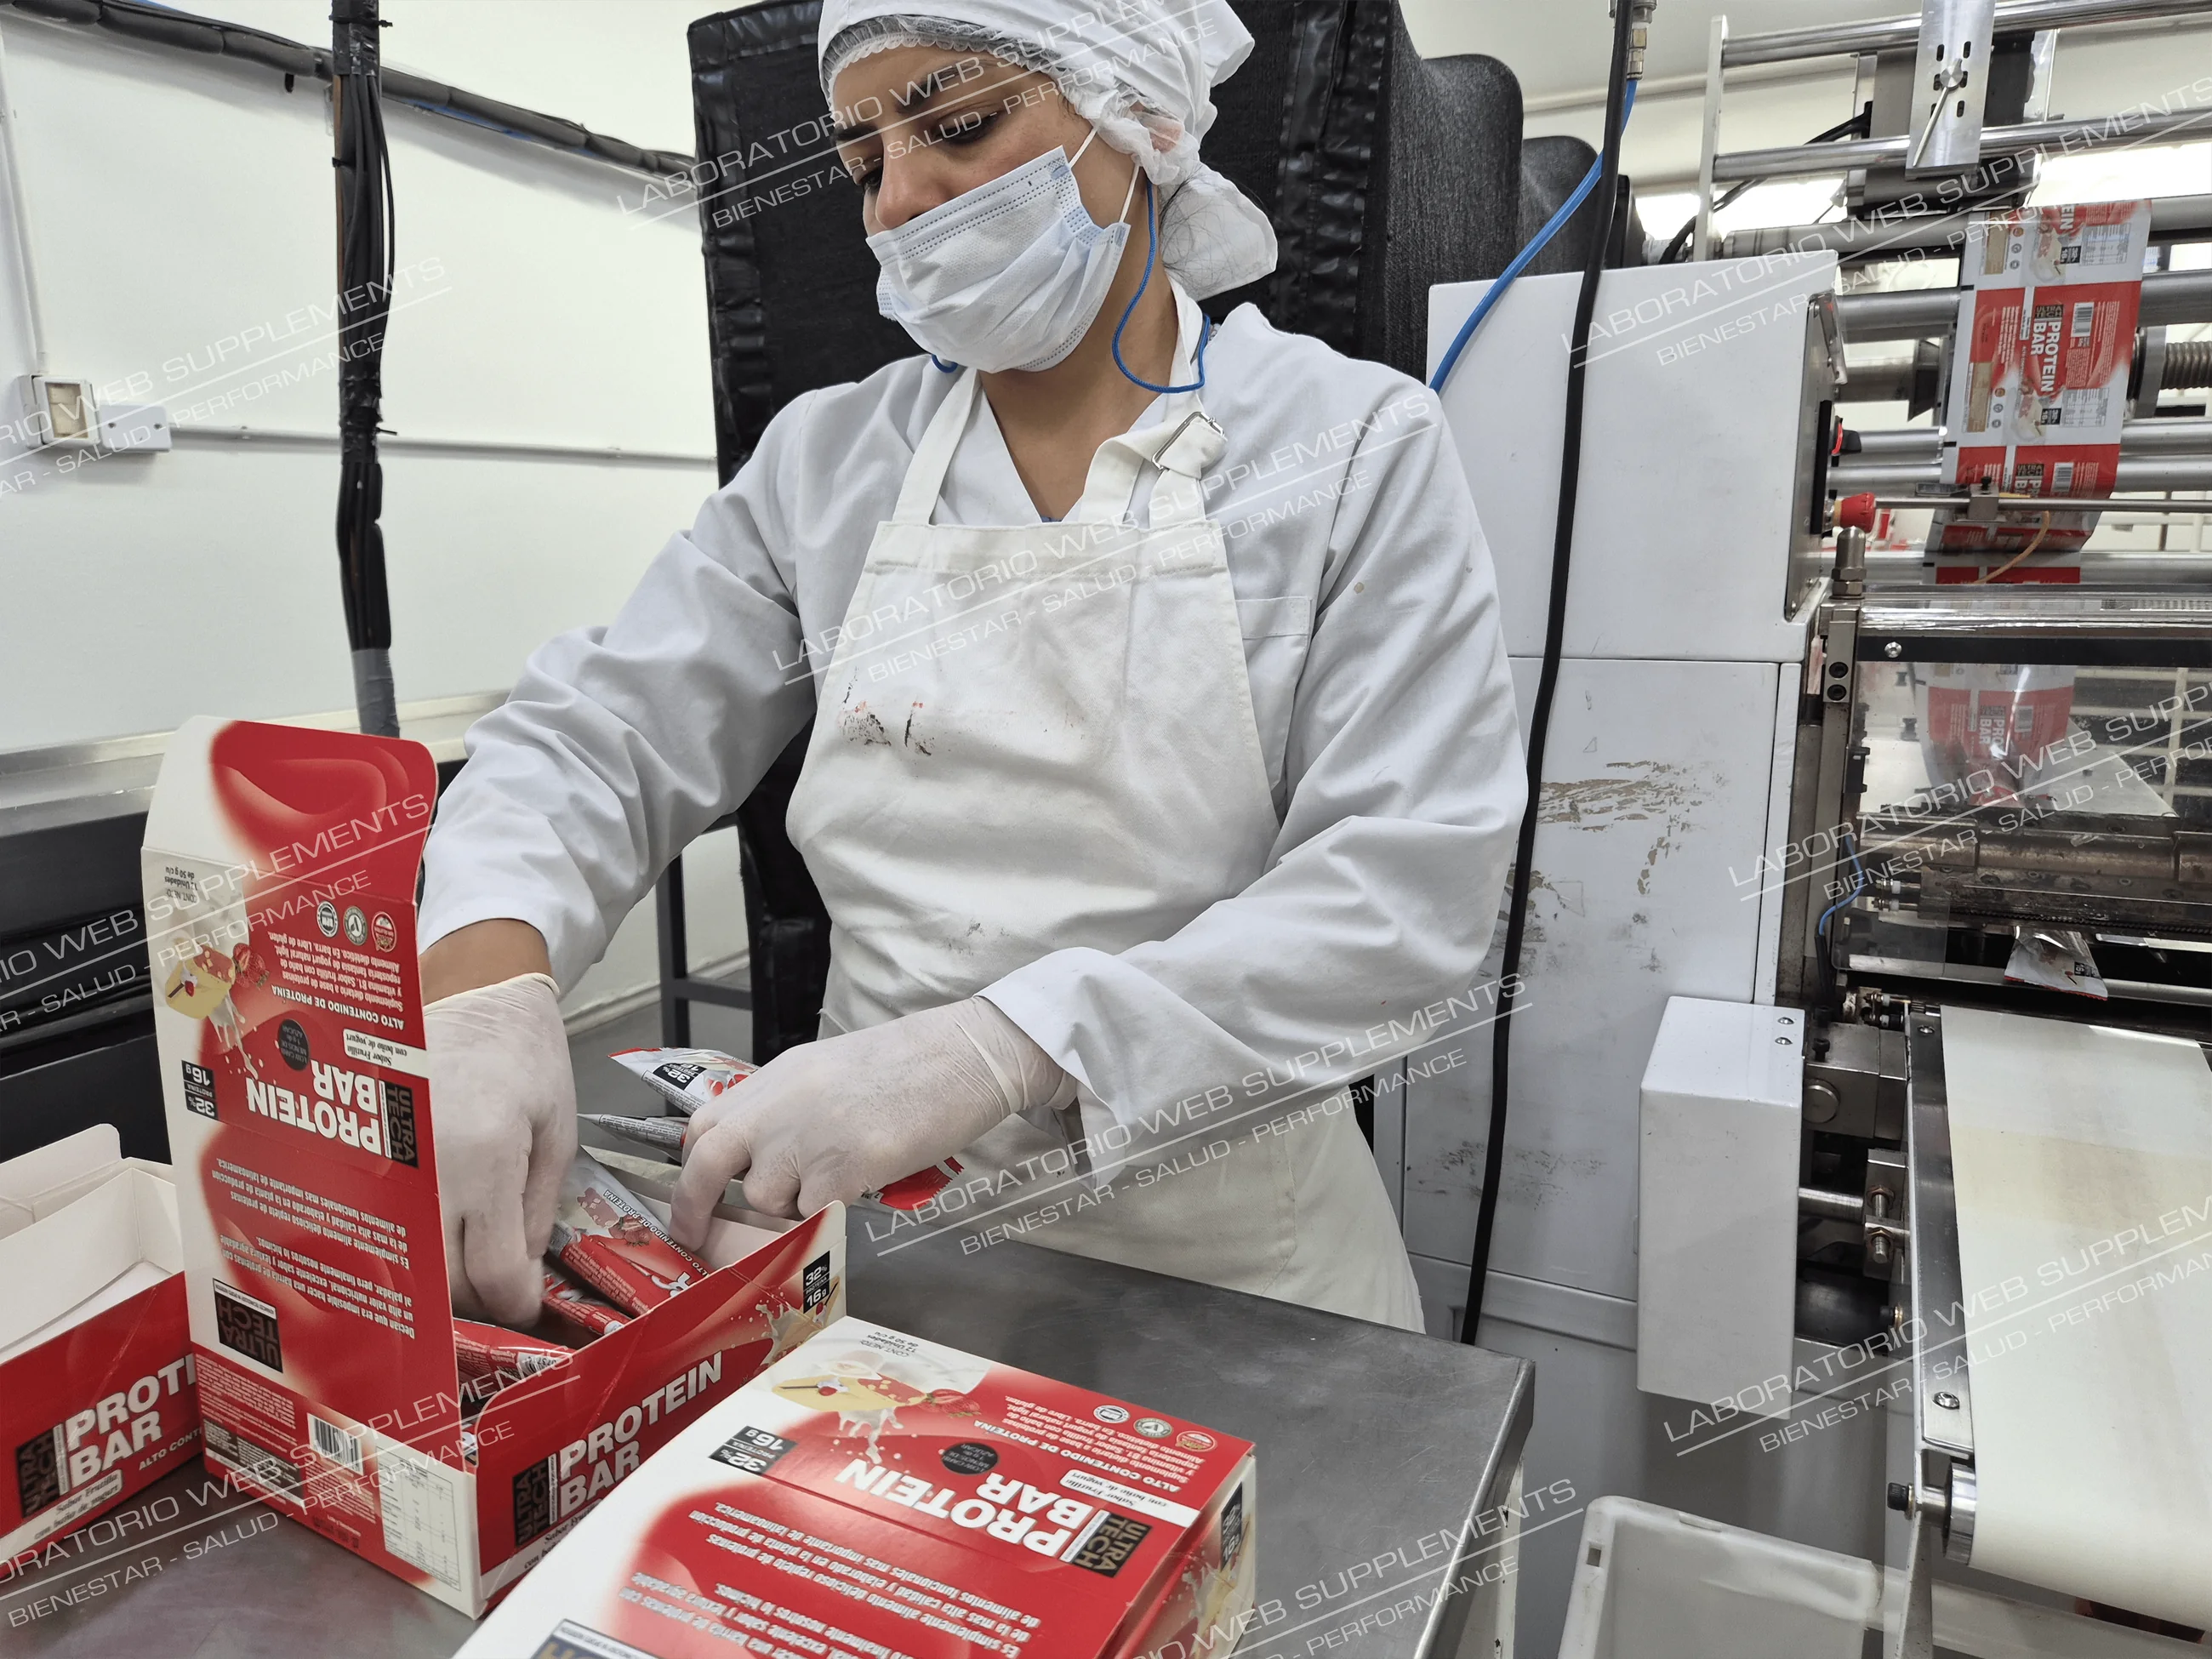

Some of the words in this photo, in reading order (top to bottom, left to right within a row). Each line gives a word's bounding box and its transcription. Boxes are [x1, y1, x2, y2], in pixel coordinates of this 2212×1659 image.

[2031, 322, 2047, 356] BAR
[2041, 322, 2062, 391] PROTEIN
[1980, 719, 1992, 744] BAR
[163, 875, 190, 890] Unidades
[178, 869, 186, 879] 50
[314, 995, 326, 1009] DE
[327, 999, 379, 1024] CONTENIDO
[379, 1013, 404, 1030] ALTO
[345, 1030, 368, 1046] yogurt
[368, 1039, 375, 1050] de
[376, 1040, 393, 1055] baño
[346, 1044, 371, 1060] Frutilla
[372, 1052, 391, 1066] Sabor
[394, 1046, 407, 1057] con
[185, 1063, 211, 1086] 16g
[310, 1058, 378, 1115] BAR
[188, 1096, 215, 1117] 32%
[244, 1075, 382, 1155] PROTEIN
[385, 1082, 403, 1161] TECH
[398, 1086, 416, 1166] ULTRA
[603, 1189, 640, 1220] PROTEINA
[649, 1225, 693, 1263] CONTENIDO
[692, 1261, 711, 1279] LTO
[805, 1265, 828, 1286] 32%
[807, 1288, 827, 1307] 16g
[216, 1295, 278, 1344] TECH
[219, 1319, 280, 1368] ULTRA
[560, 1348, 722, 1484] PROTEIN
[68, 1405, 162, 1491] BAR
[738, 1427, 790, 1452] 16g
[1038, 1440, 1061, 1453] DE
[138, 1446, 167, 1471] ALTO
[713, 1445, 769, 1474] 32%
[1058, 1447, 1143, 1481] CONTENIDO
[560, 1434, 640, 1519] BAR
[1140, 1474, 1181, 1494] ALTO
[532, 1462, 548, 1532] TECH
[832, 1454, 1073, 1561] PROTEIN
[971, 1470, 1094, 1531] BAR
[744, 1531, 767, 1545] de
[760, 1535, 803, 1559] planta
[1073, 1513, 1129, 1570] TECH
[1092, 1519, 1149, 1576] ULTRA
[754, 1551, 776, 1565] de
[769, 1555, 817, 1582] repleto
[795, 1549, 814, 1563] la
[809, 1554, 830, 1567] en
[809, 1571, 869, 1602] delicioso
[824, 1559, 889, 1592] elaborado
[883, 1580, 899, 1593] y
[863, 1591, 923, 1622] alimento
[892, 1584, 944, 1612] calidad
[937, 1600, 969, 1621] alta
[915, 1610, 1004, 1654] simplemente
[992, 1622, 1012, 1637] la
[1006, 1627, 1031, 1645] de
[997, 1641, 1021, 1659] Es
